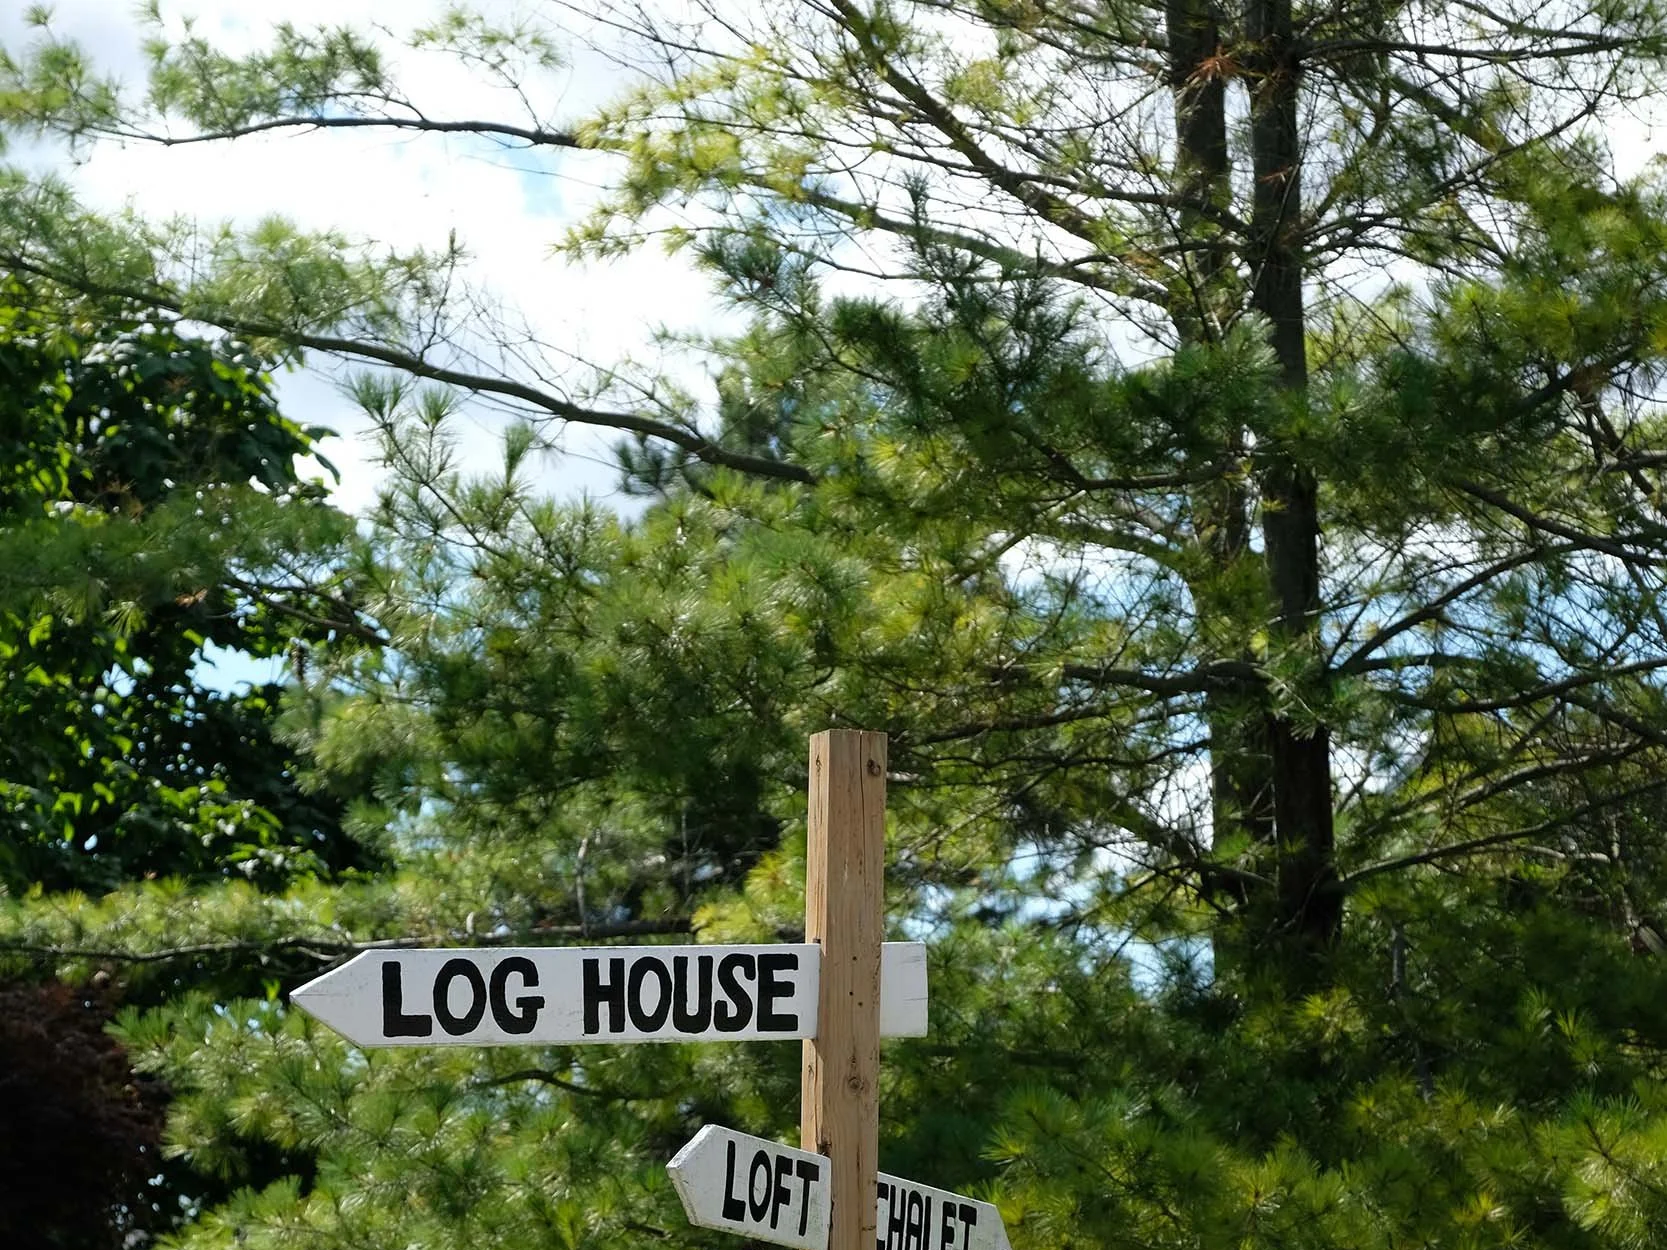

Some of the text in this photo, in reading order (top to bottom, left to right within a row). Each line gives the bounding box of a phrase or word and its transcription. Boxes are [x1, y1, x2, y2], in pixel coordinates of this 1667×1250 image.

[381, 953, 799, 1037] LOG HOUSE
[722, 1140, 820, 1237] LOFT
